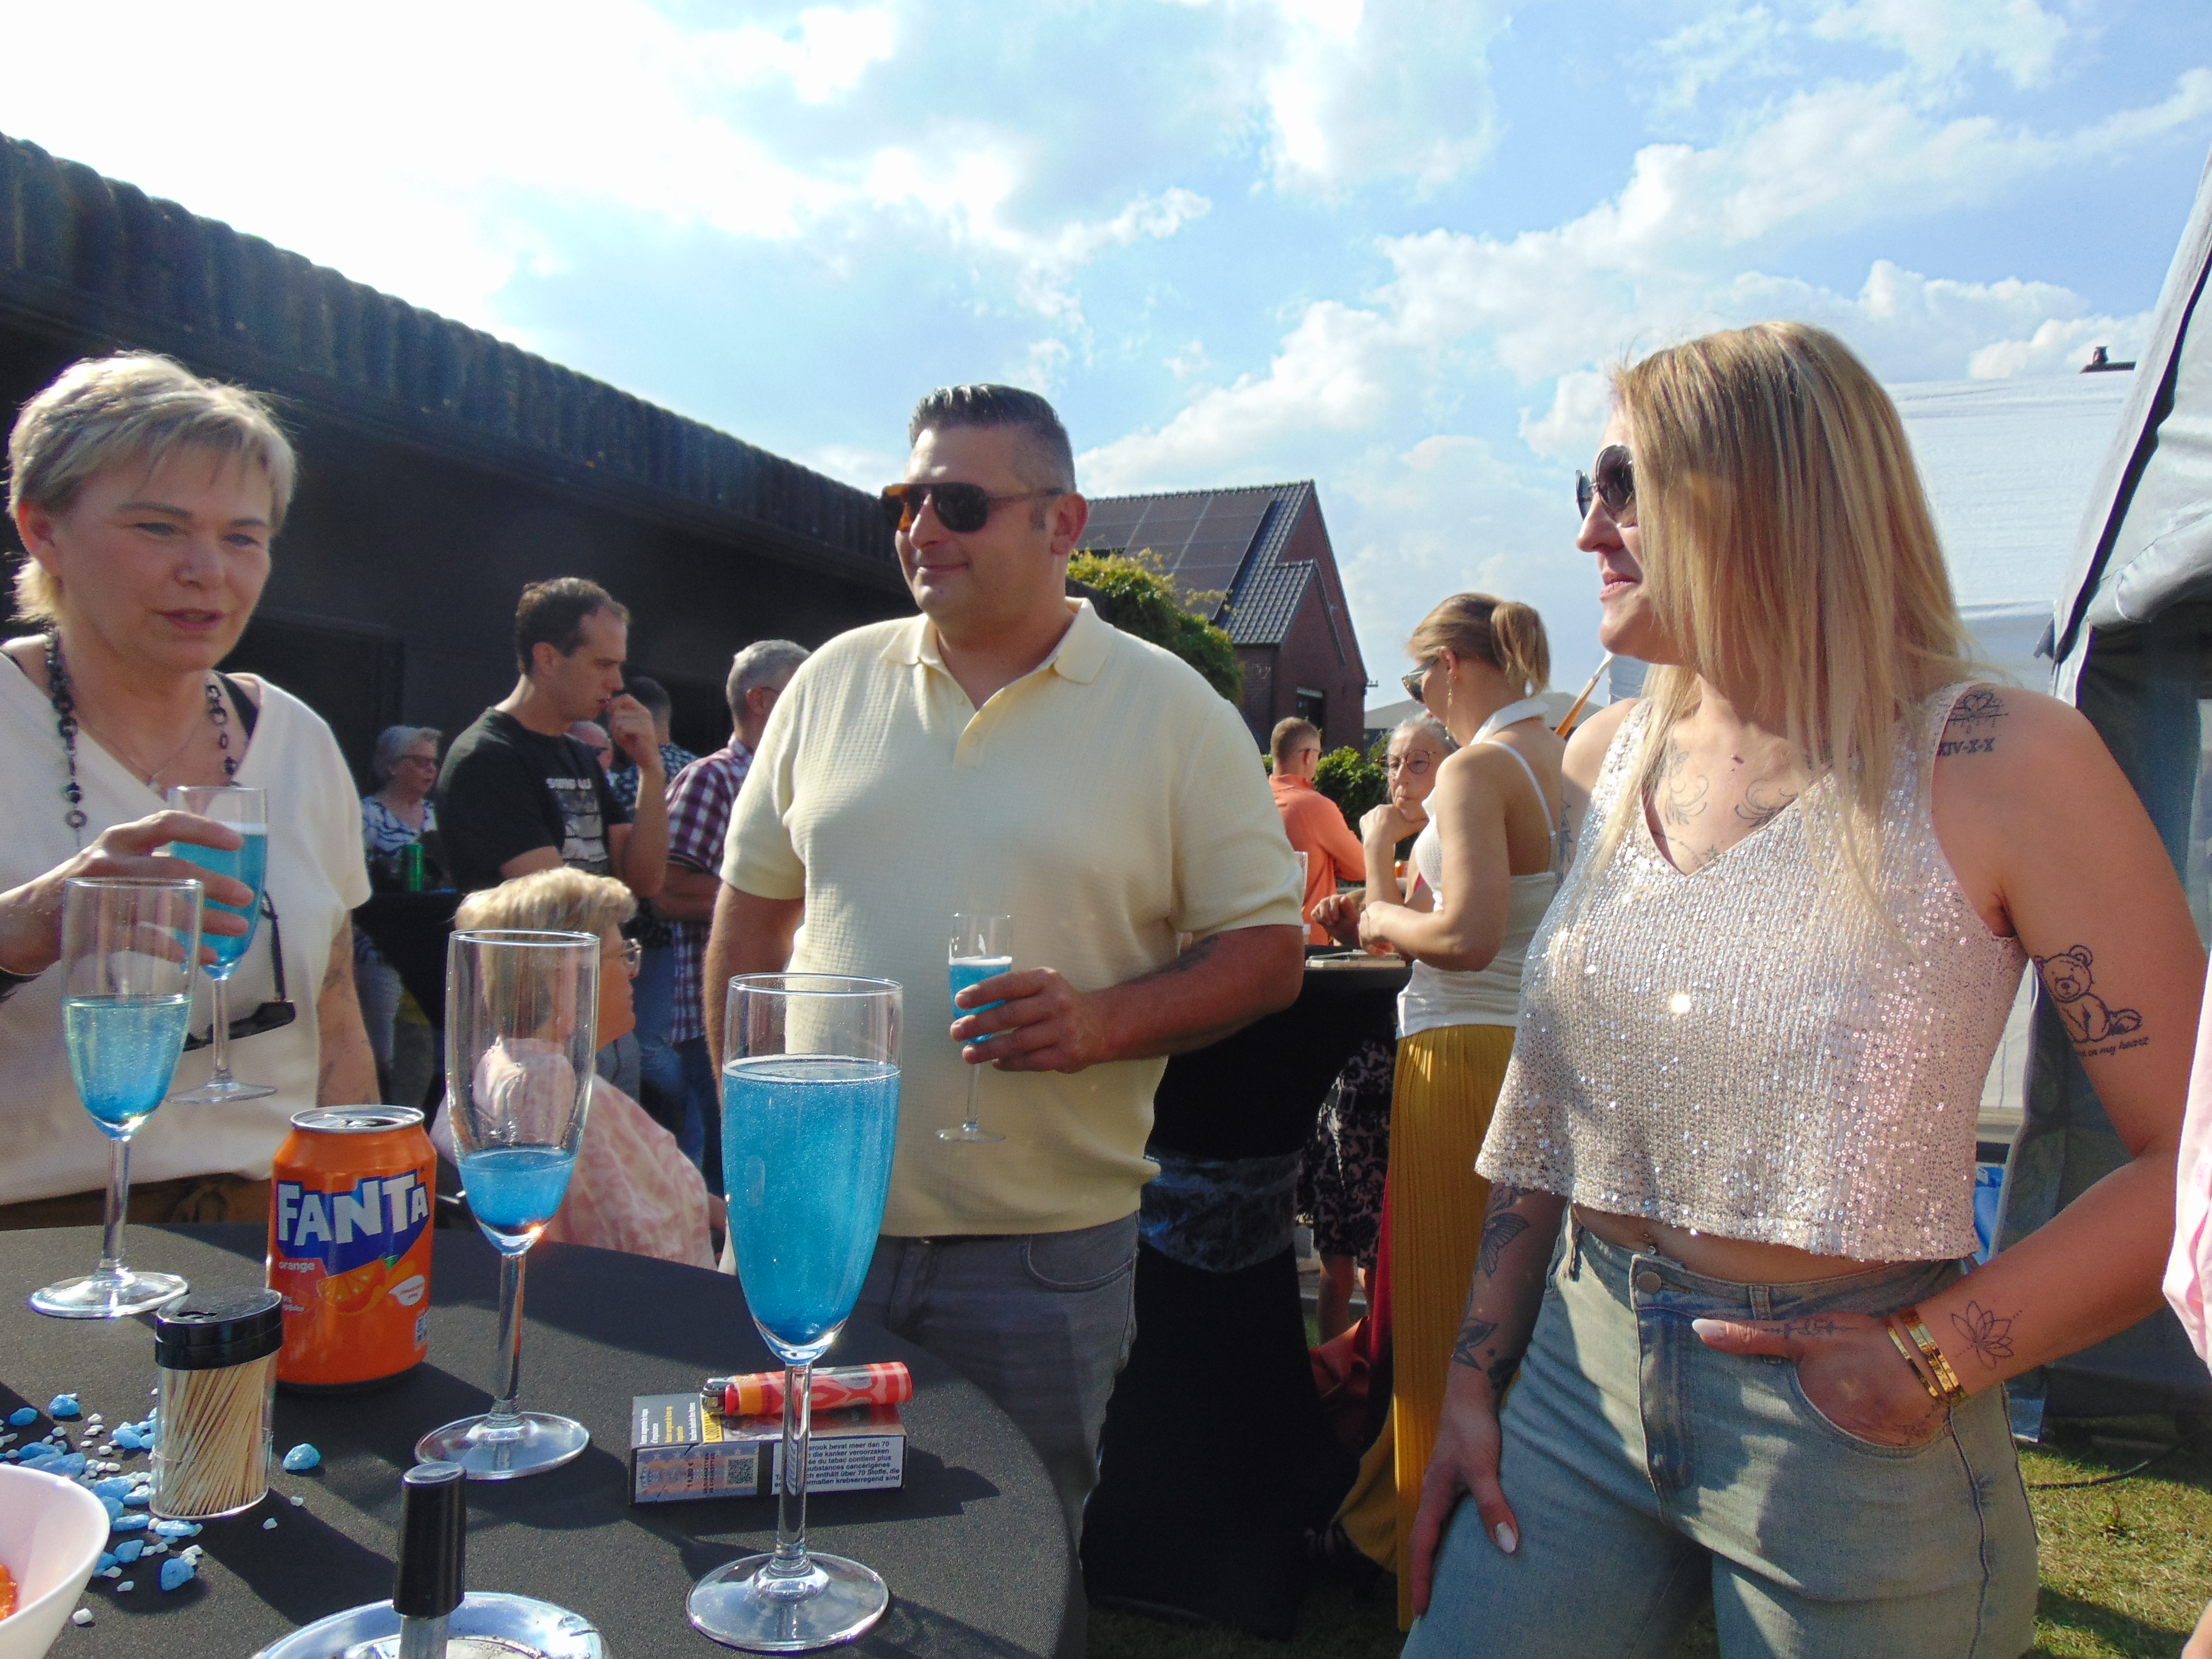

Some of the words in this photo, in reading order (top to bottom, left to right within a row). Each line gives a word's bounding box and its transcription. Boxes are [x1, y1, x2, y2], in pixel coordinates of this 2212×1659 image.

[278, 1173, 428, 1246] FANTA
[279, 1261, 315, 1273] orange
[836, 1476, 884, 1484] krebserregend
